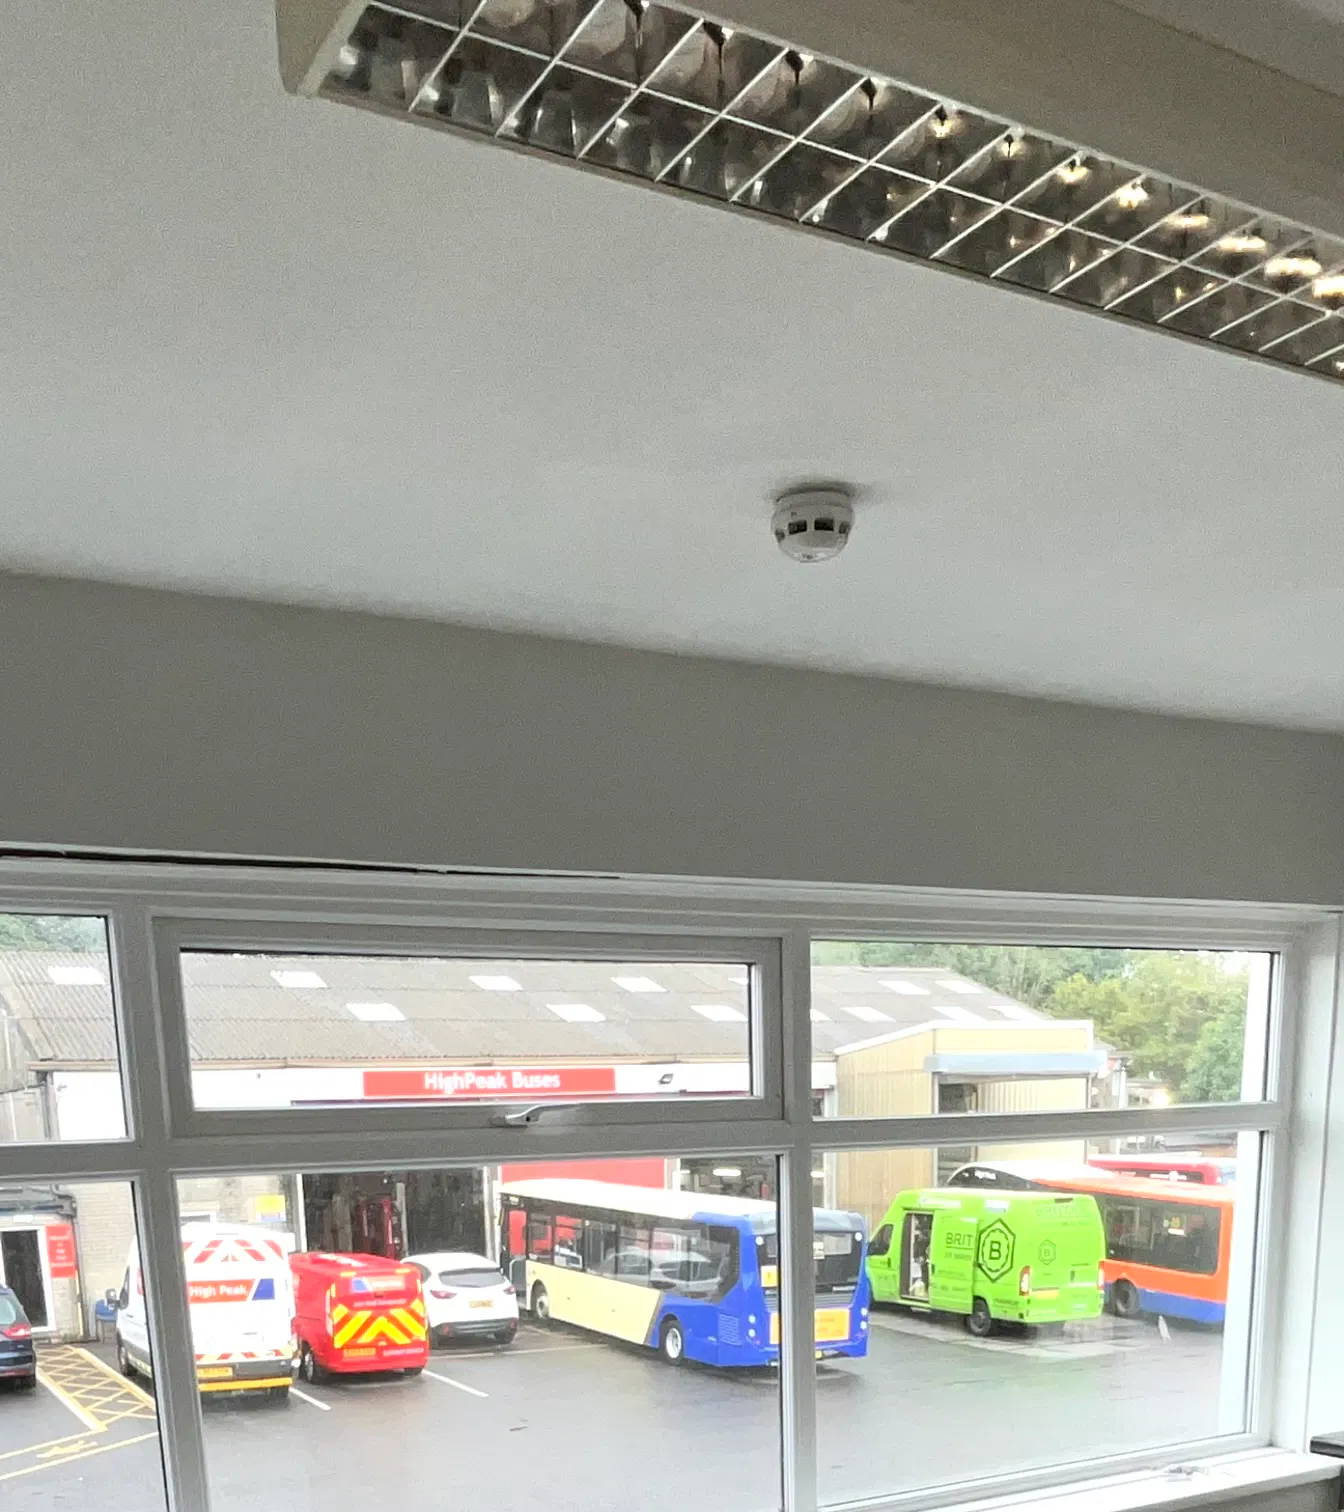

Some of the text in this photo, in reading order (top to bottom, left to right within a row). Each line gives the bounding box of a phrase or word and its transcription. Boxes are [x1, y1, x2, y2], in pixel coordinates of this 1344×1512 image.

[512, 1071, 560, 1089] Buses
[989, 1240, 1001, 1260] B
[189, 1284, 246, 1299] High Peak
